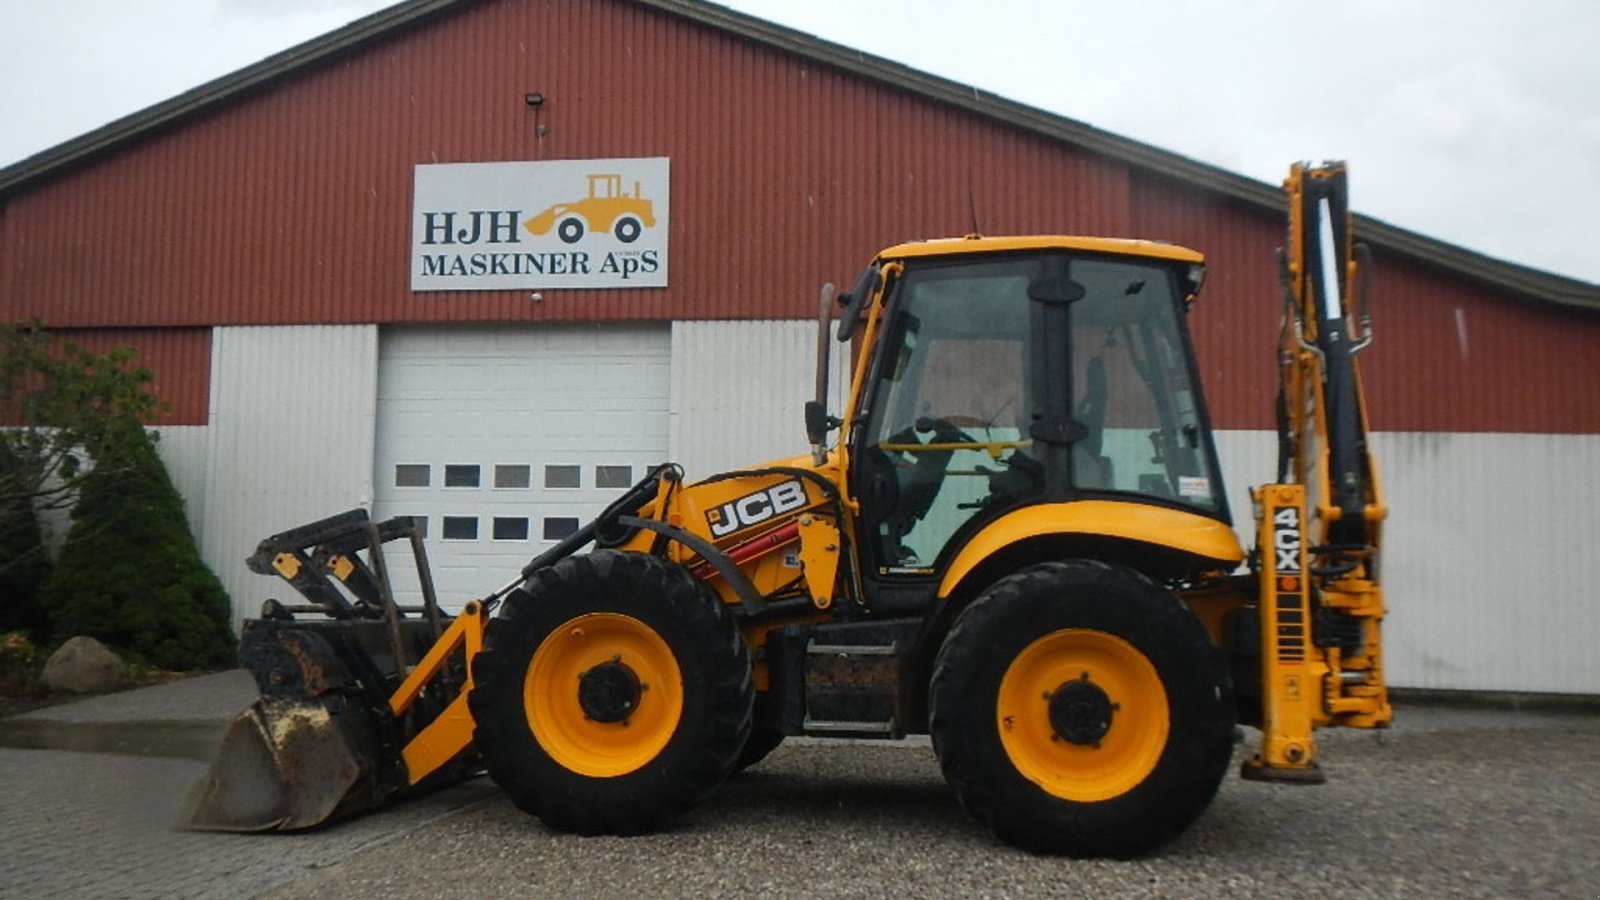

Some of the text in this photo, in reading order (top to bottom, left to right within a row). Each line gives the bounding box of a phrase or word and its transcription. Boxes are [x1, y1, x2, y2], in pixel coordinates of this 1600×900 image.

[421, 211, 522, 245] HJH
[421, 250, 658, 279] MASKINER ApS
[711, 480, 806, 536] JCB
[1274, 508, 1300, 570] 4CX
